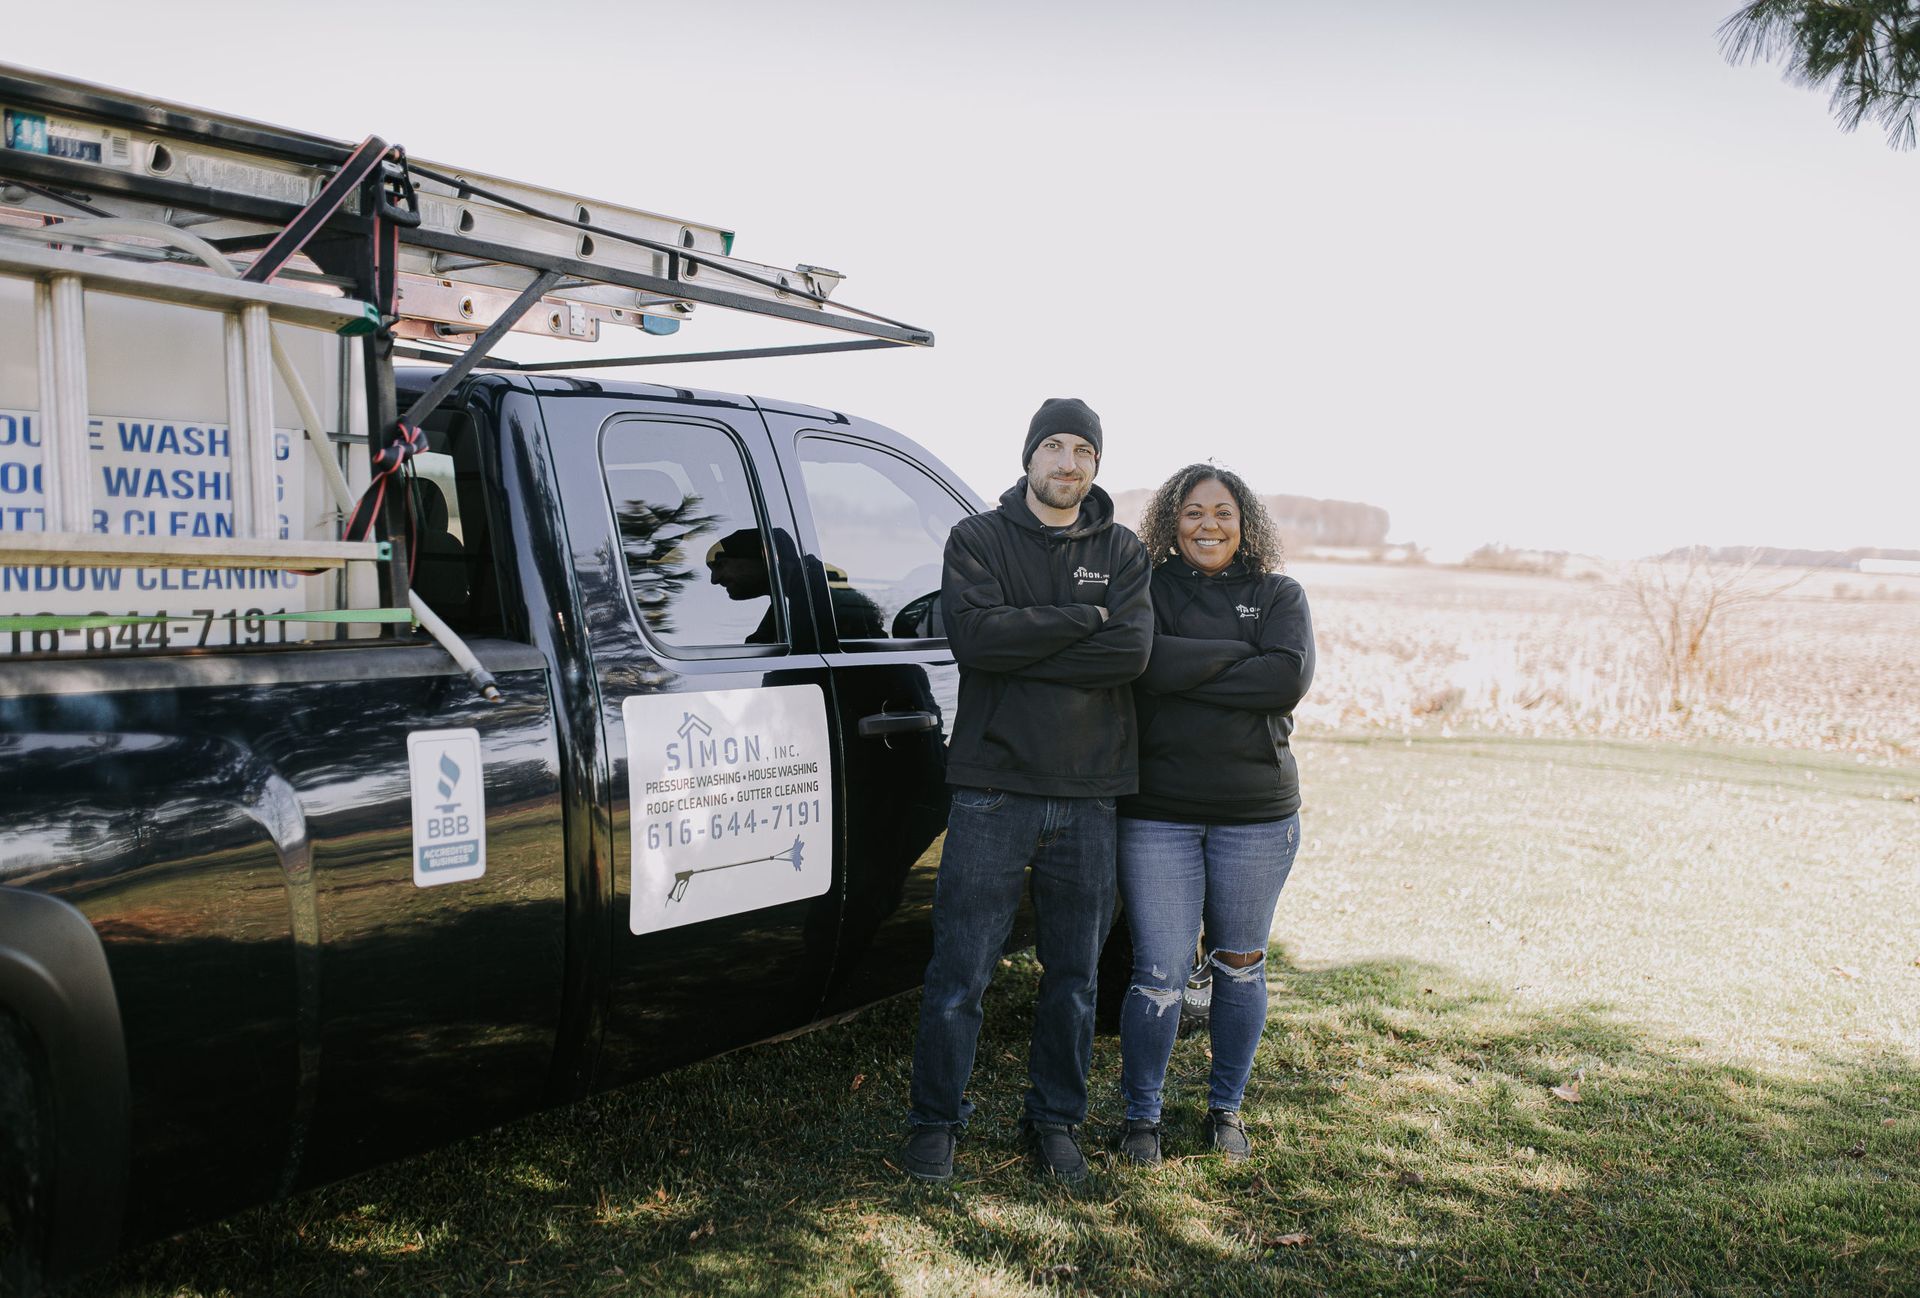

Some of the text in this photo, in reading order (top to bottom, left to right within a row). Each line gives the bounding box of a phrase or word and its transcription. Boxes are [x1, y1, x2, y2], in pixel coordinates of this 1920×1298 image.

[0, 414, 290, 461] OUE WASHG
[102, 466, 284, 502] WASHI
[3, 566, 298, 592] NDOW CLEANING
[10, 608, 287, 652] 16-644-7191
[774, 745, 800, 760] INC.
[646, 762, 818, 795] PRESSURE WASHING HOUSE WASHING
[646, 780, 819, 815] ROOF CLEANING GUTTER CLEANING
[428, 815, 470, 839] BBB
[647, 799, 821, 850] 616-644-7191
[1184, 994, 1212, 1009] rich
